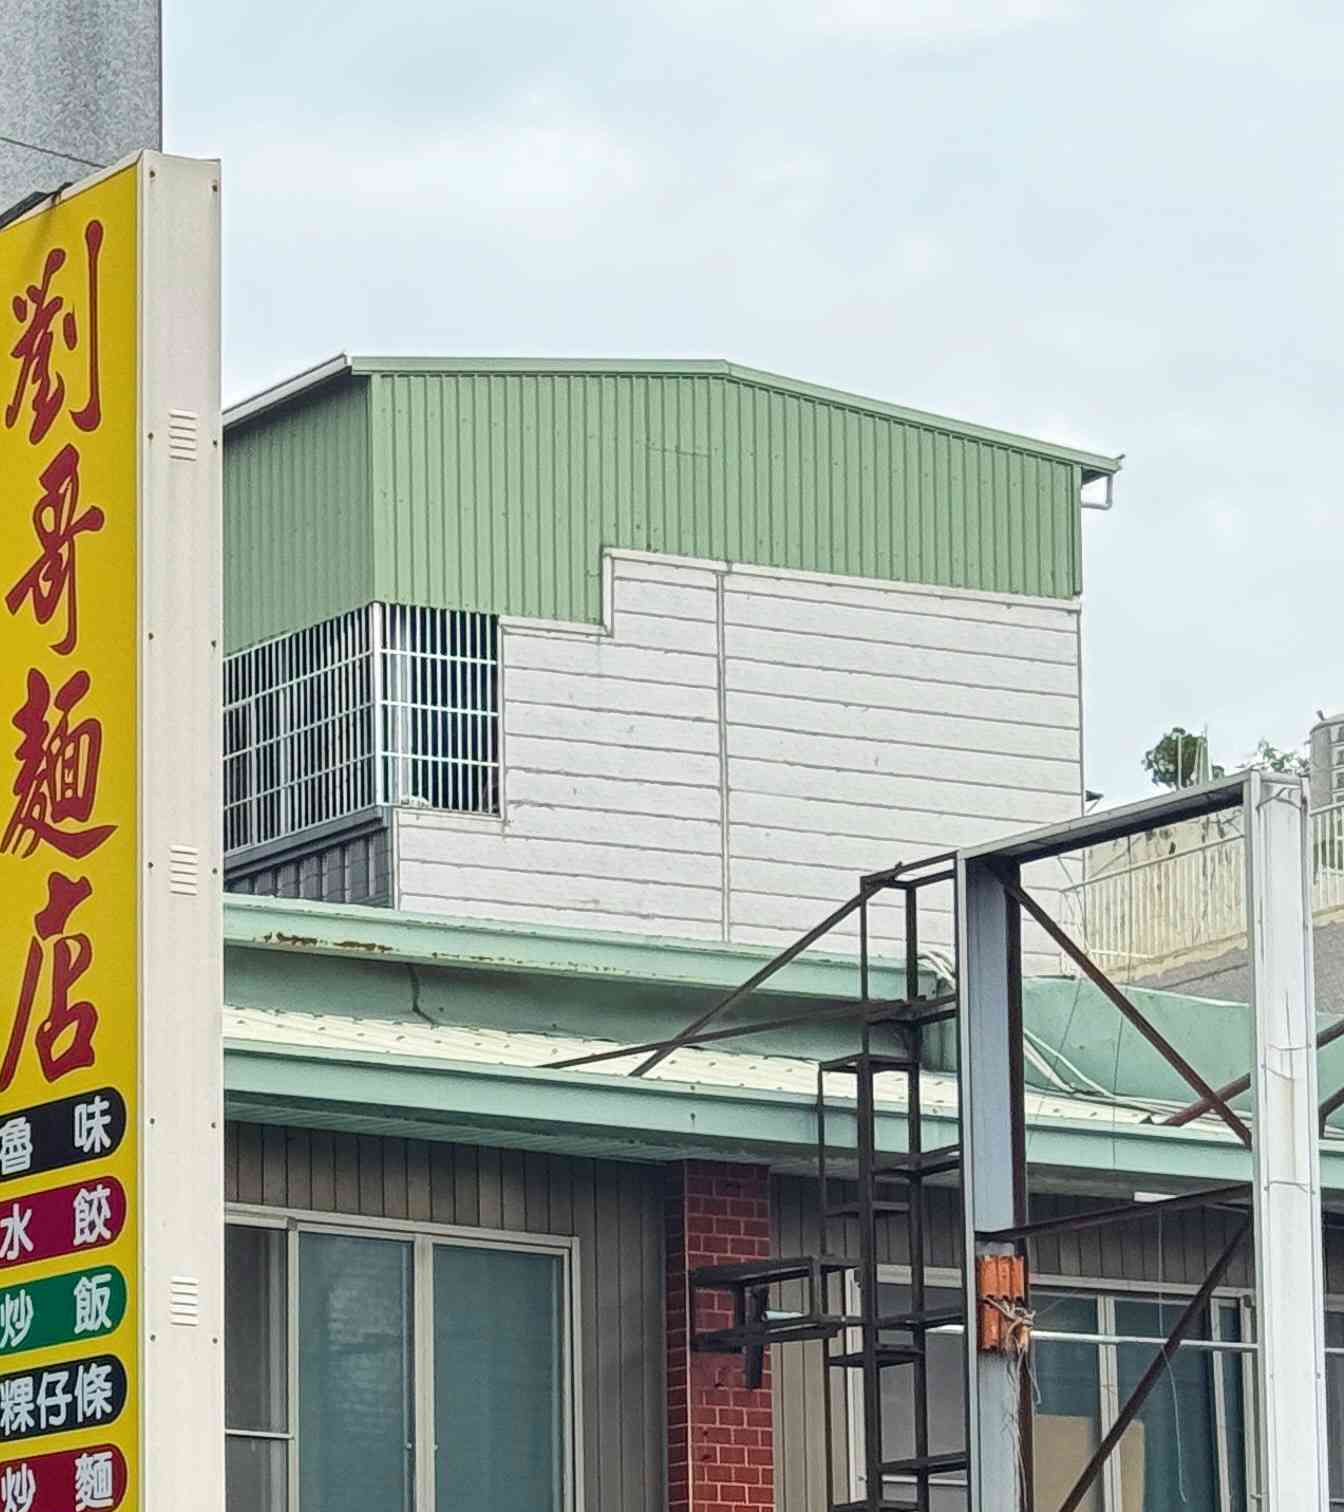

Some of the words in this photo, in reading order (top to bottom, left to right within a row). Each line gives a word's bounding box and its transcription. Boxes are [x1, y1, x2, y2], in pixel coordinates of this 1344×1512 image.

[0, 220, 117, 1092] 劉哥麵店
[0, 1186, 112, 1262] 水餃
[0, 1272, 112, 1351] 炒飯
